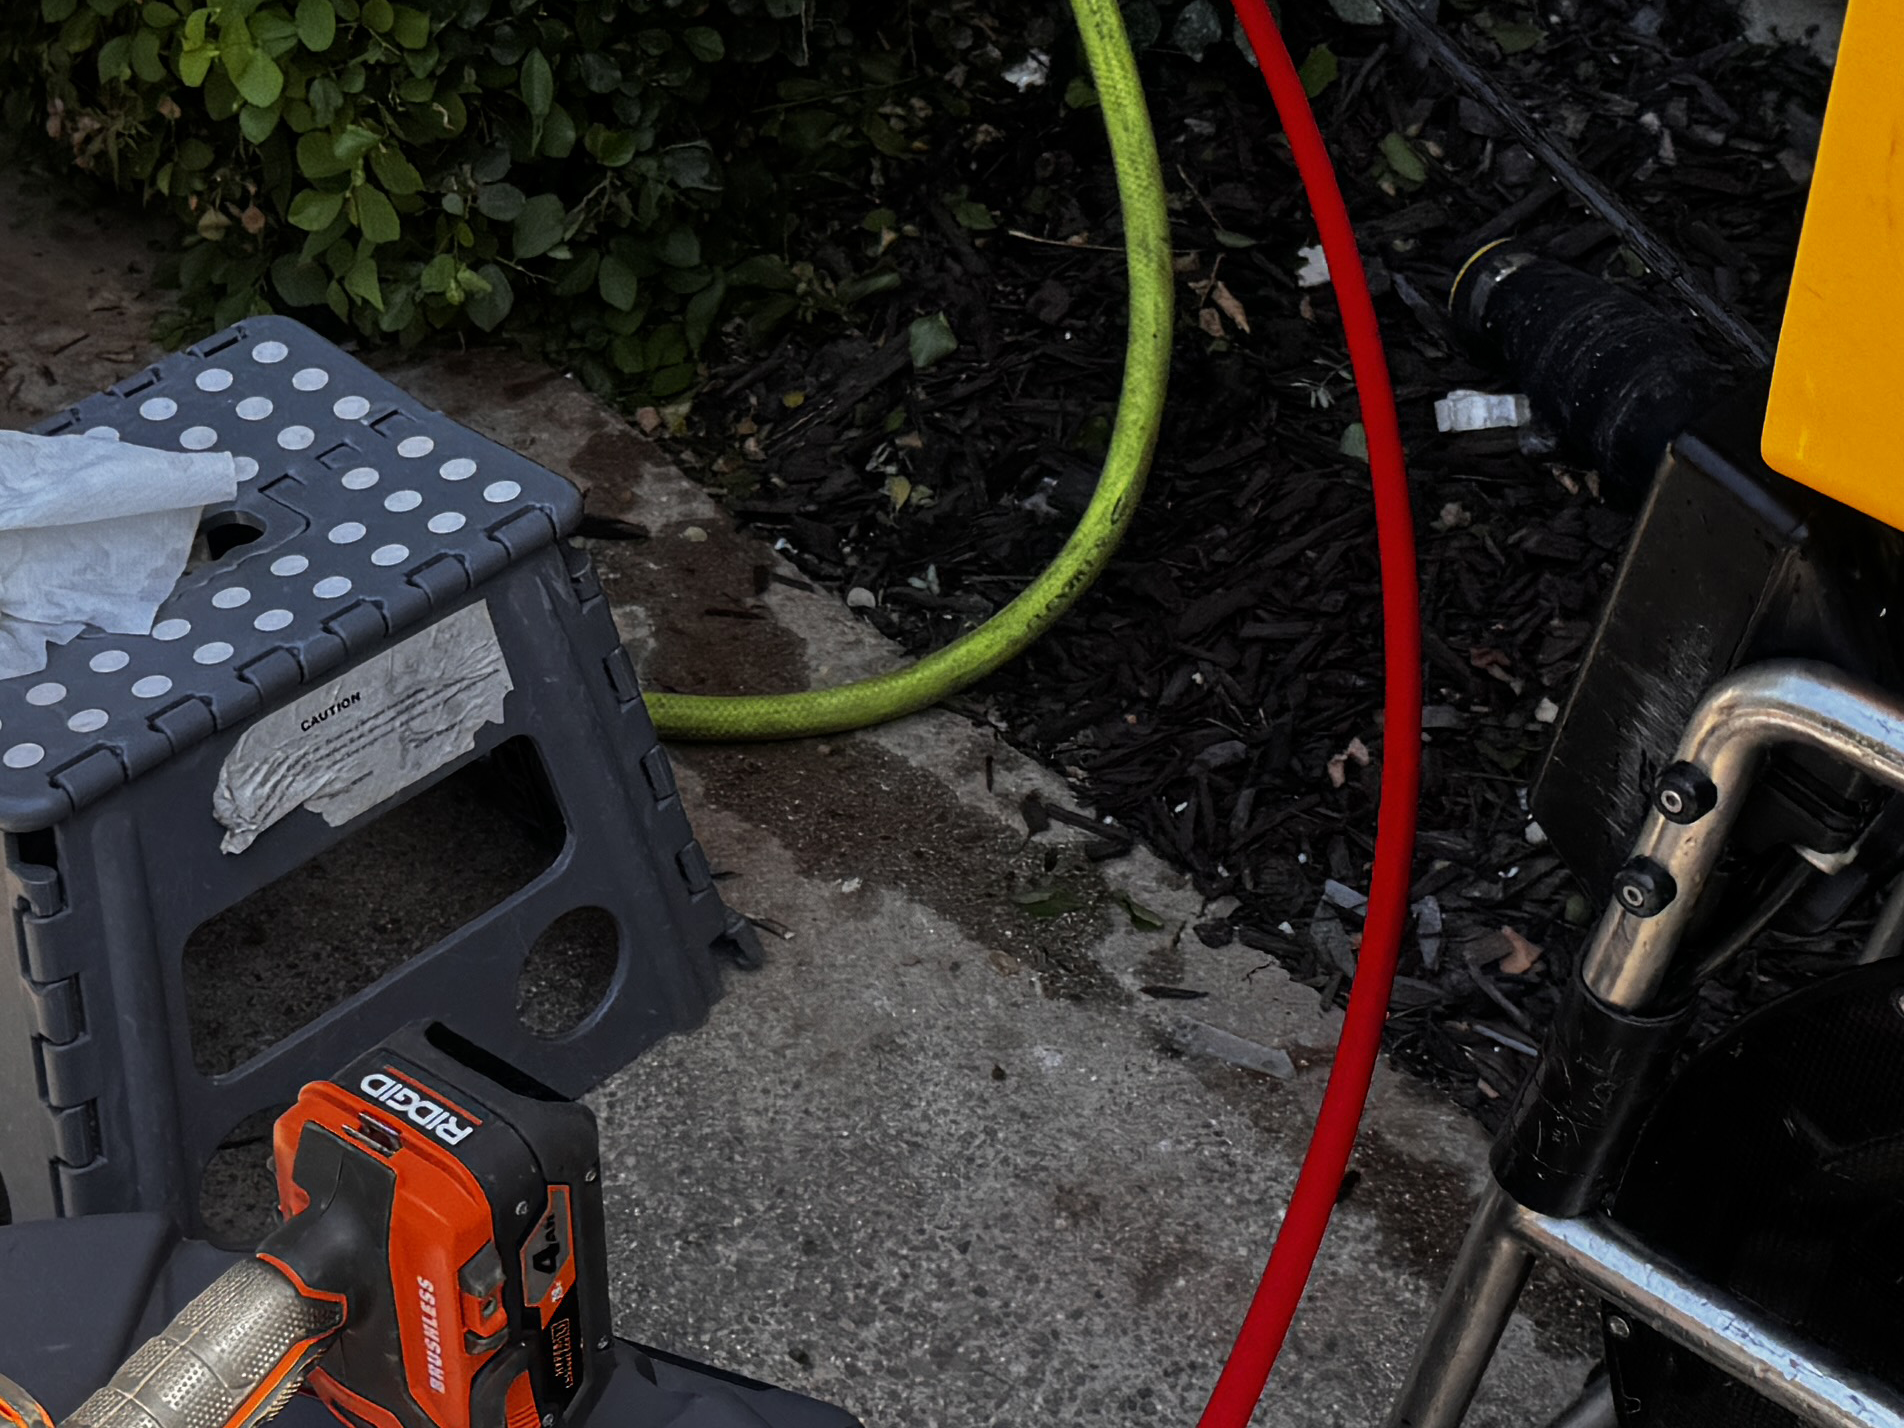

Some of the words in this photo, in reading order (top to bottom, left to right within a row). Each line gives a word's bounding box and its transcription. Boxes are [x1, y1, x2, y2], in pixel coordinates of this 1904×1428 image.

[300, 692, 361, 732] CAUTION
[360, 1073, 474, 1146] RIDGID
[416, 1275, 446, 1394] BRUSHLESS
